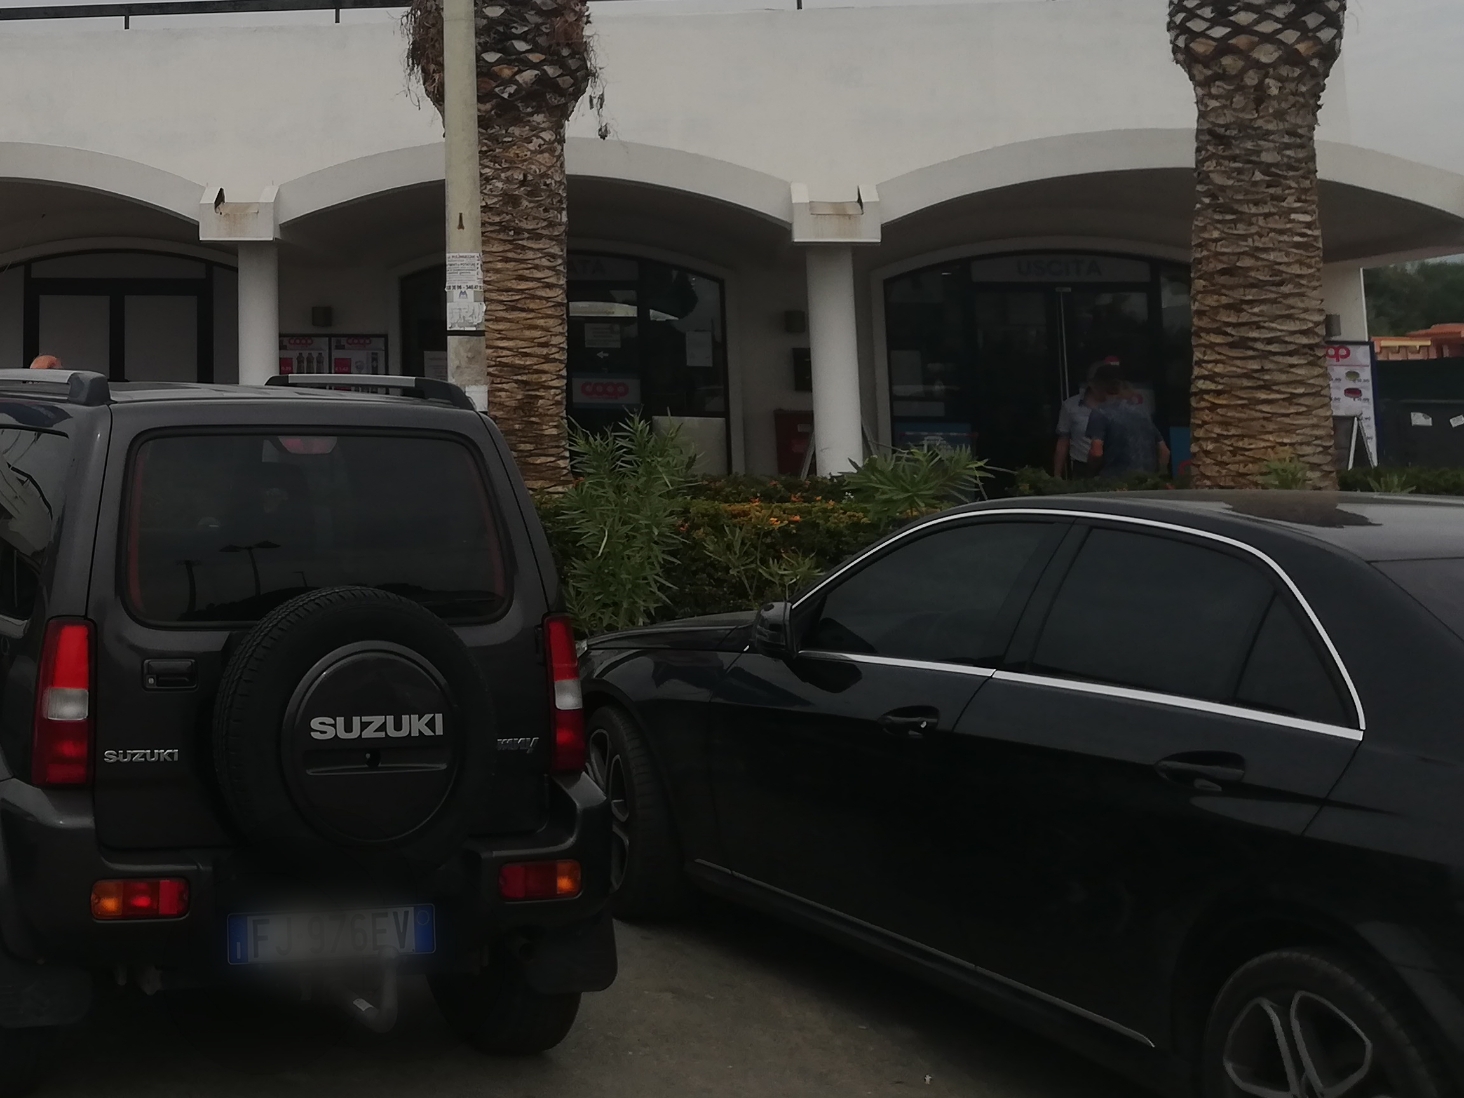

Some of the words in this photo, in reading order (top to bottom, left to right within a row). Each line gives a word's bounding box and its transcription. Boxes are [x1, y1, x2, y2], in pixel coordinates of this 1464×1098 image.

[1016, 259, 1102, 277] USCITA
[581, 382, 629, 399] coop
[309, 713, 444, 741] SUZUKI
[104, 749, 179, 763] SUZUKI
